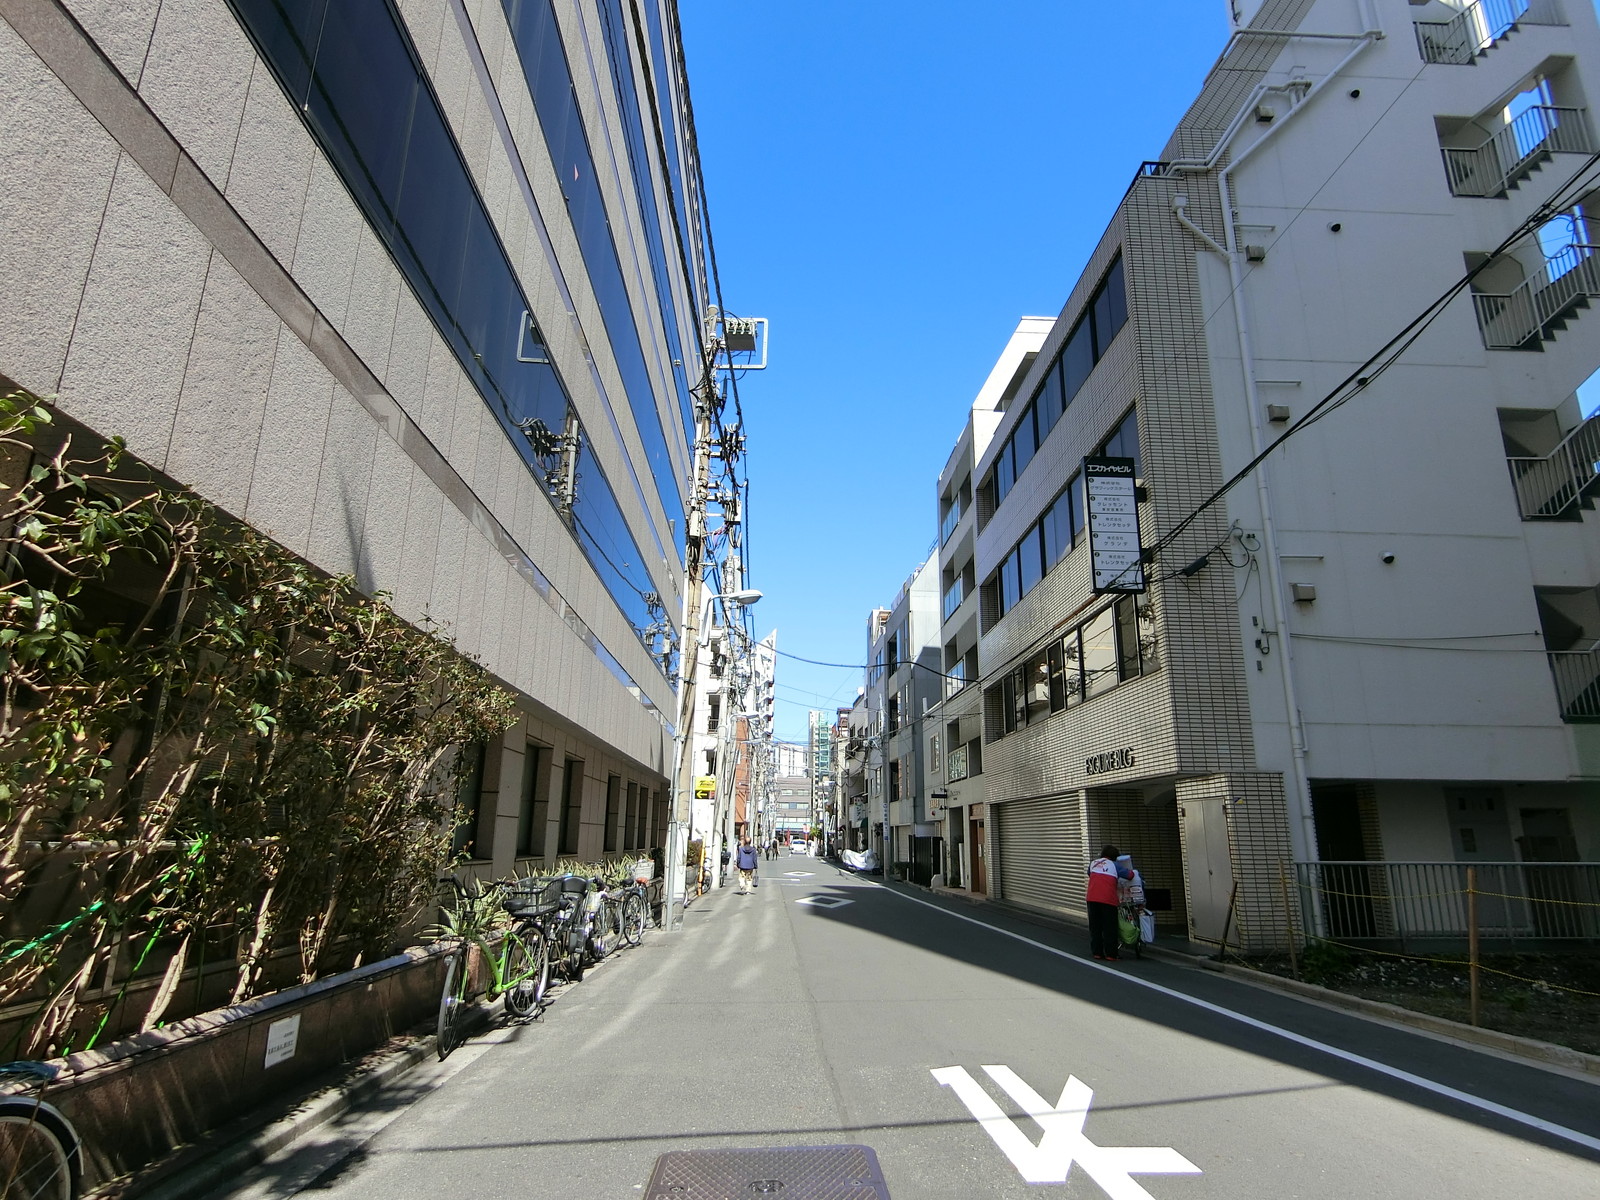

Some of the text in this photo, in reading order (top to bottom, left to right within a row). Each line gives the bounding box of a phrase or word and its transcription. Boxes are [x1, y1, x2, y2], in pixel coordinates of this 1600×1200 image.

[1087, 464, 1132, 473] エスカイヤビル
